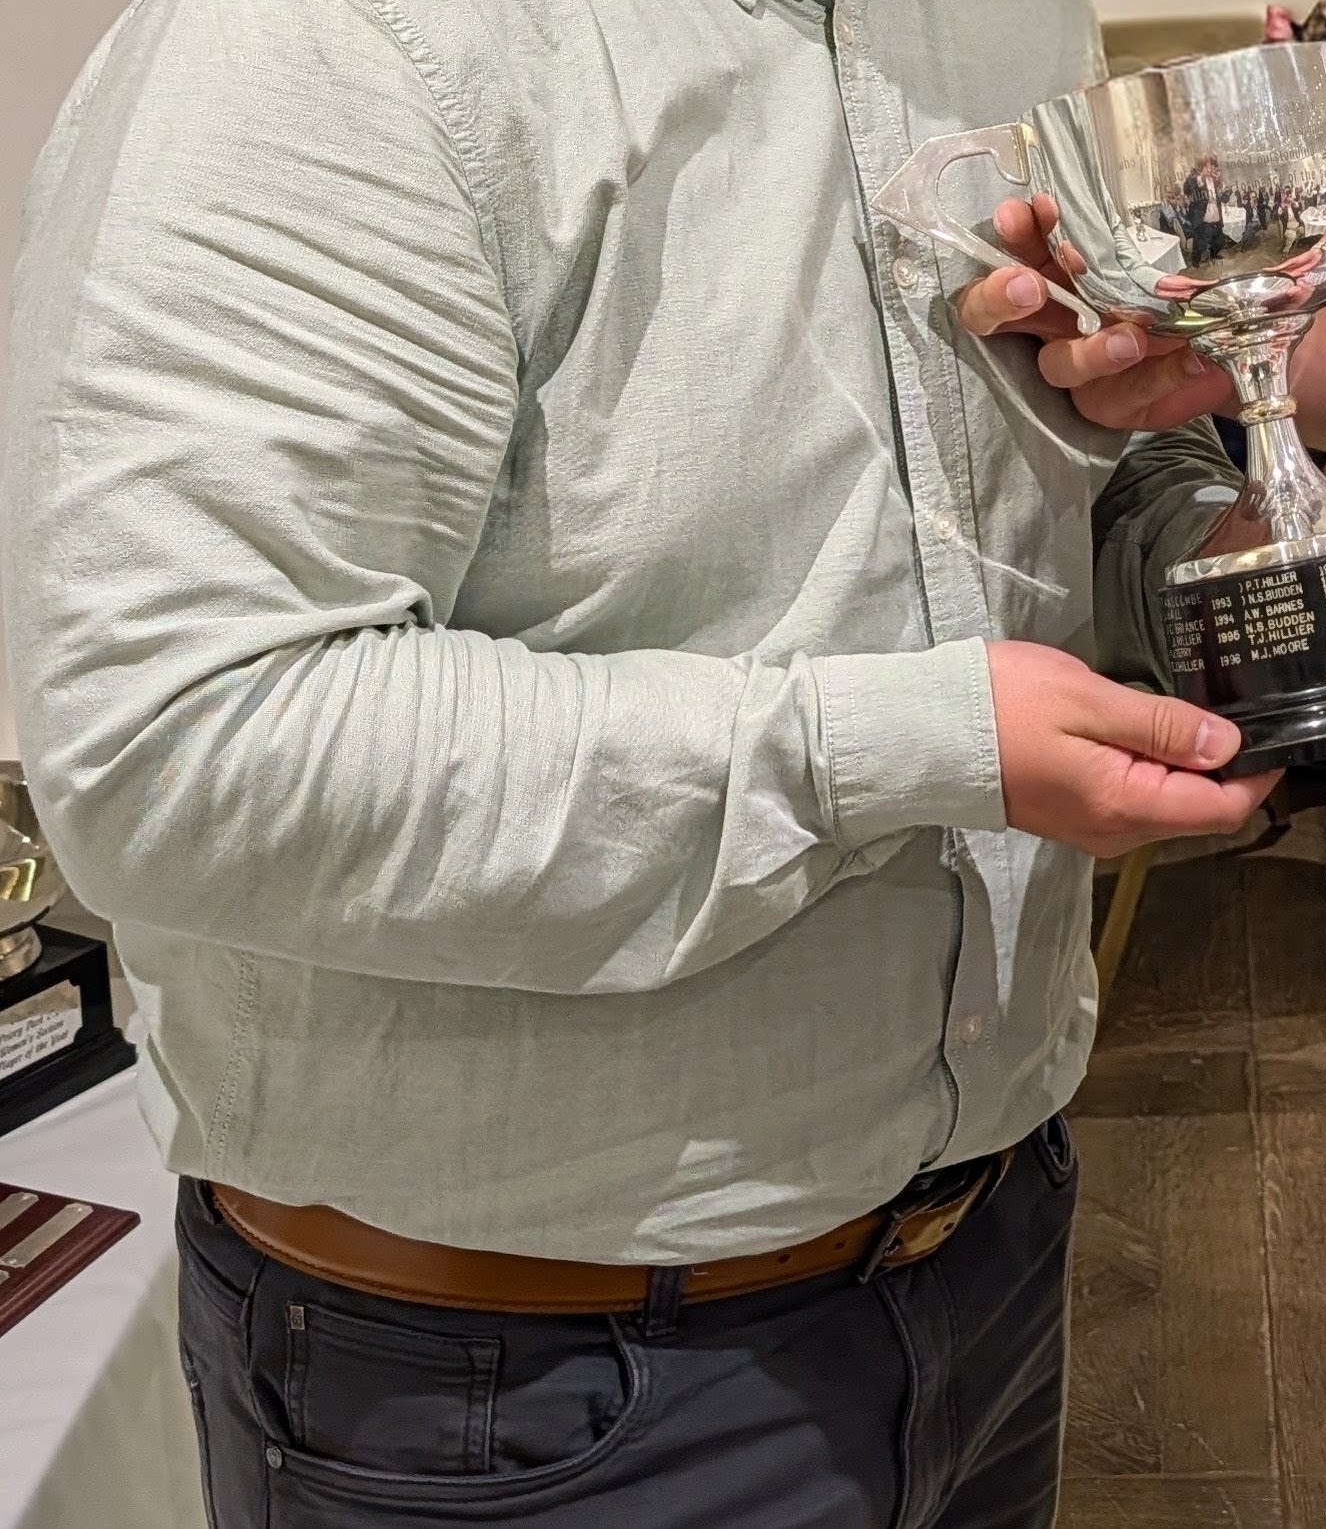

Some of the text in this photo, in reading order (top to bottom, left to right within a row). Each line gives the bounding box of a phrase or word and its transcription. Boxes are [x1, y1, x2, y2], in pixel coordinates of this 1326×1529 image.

[1288, 169, 1298, 183] of
[1301, 168, 1316, 182] the
[1211, 596, 1232, 610] 1993
[1214, 614, 1235, 627] 1994
[1265, 598, 1304, 617] BARNES
